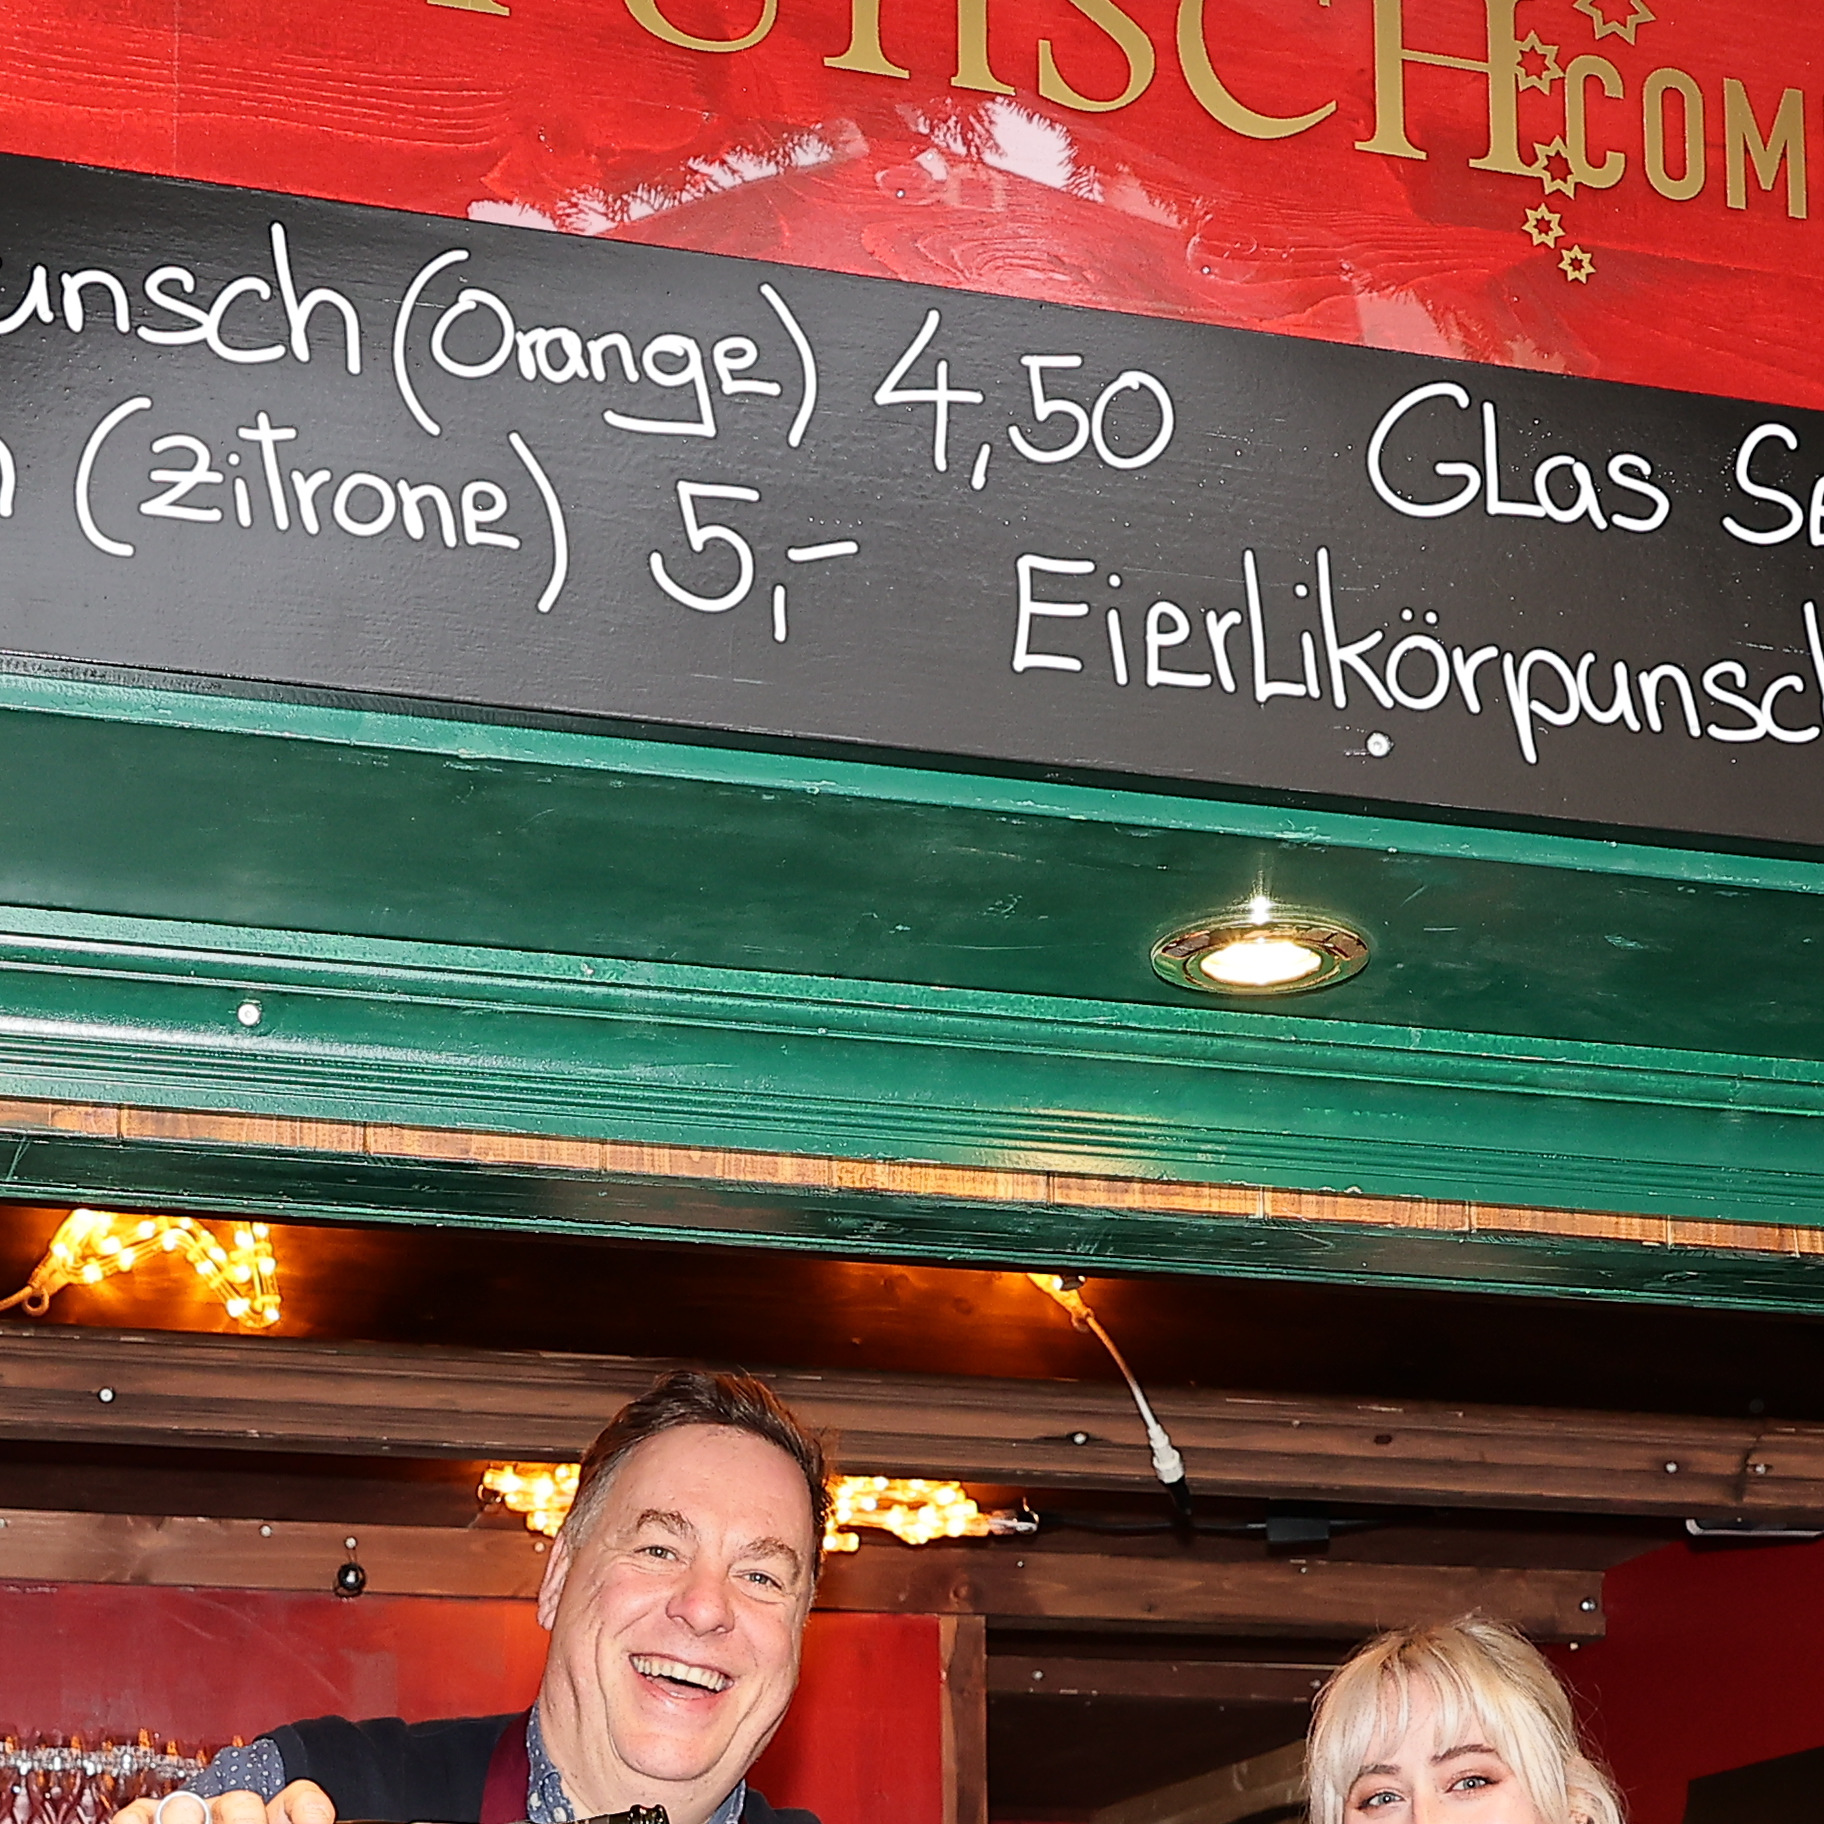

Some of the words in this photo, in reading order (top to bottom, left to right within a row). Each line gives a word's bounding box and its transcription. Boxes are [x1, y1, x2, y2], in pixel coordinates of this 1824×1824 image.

[393, 250, 818, 448] (Orange)
[873, 309, 1174, 490] 4,50
[649, 480, 859, 642] 5,-
